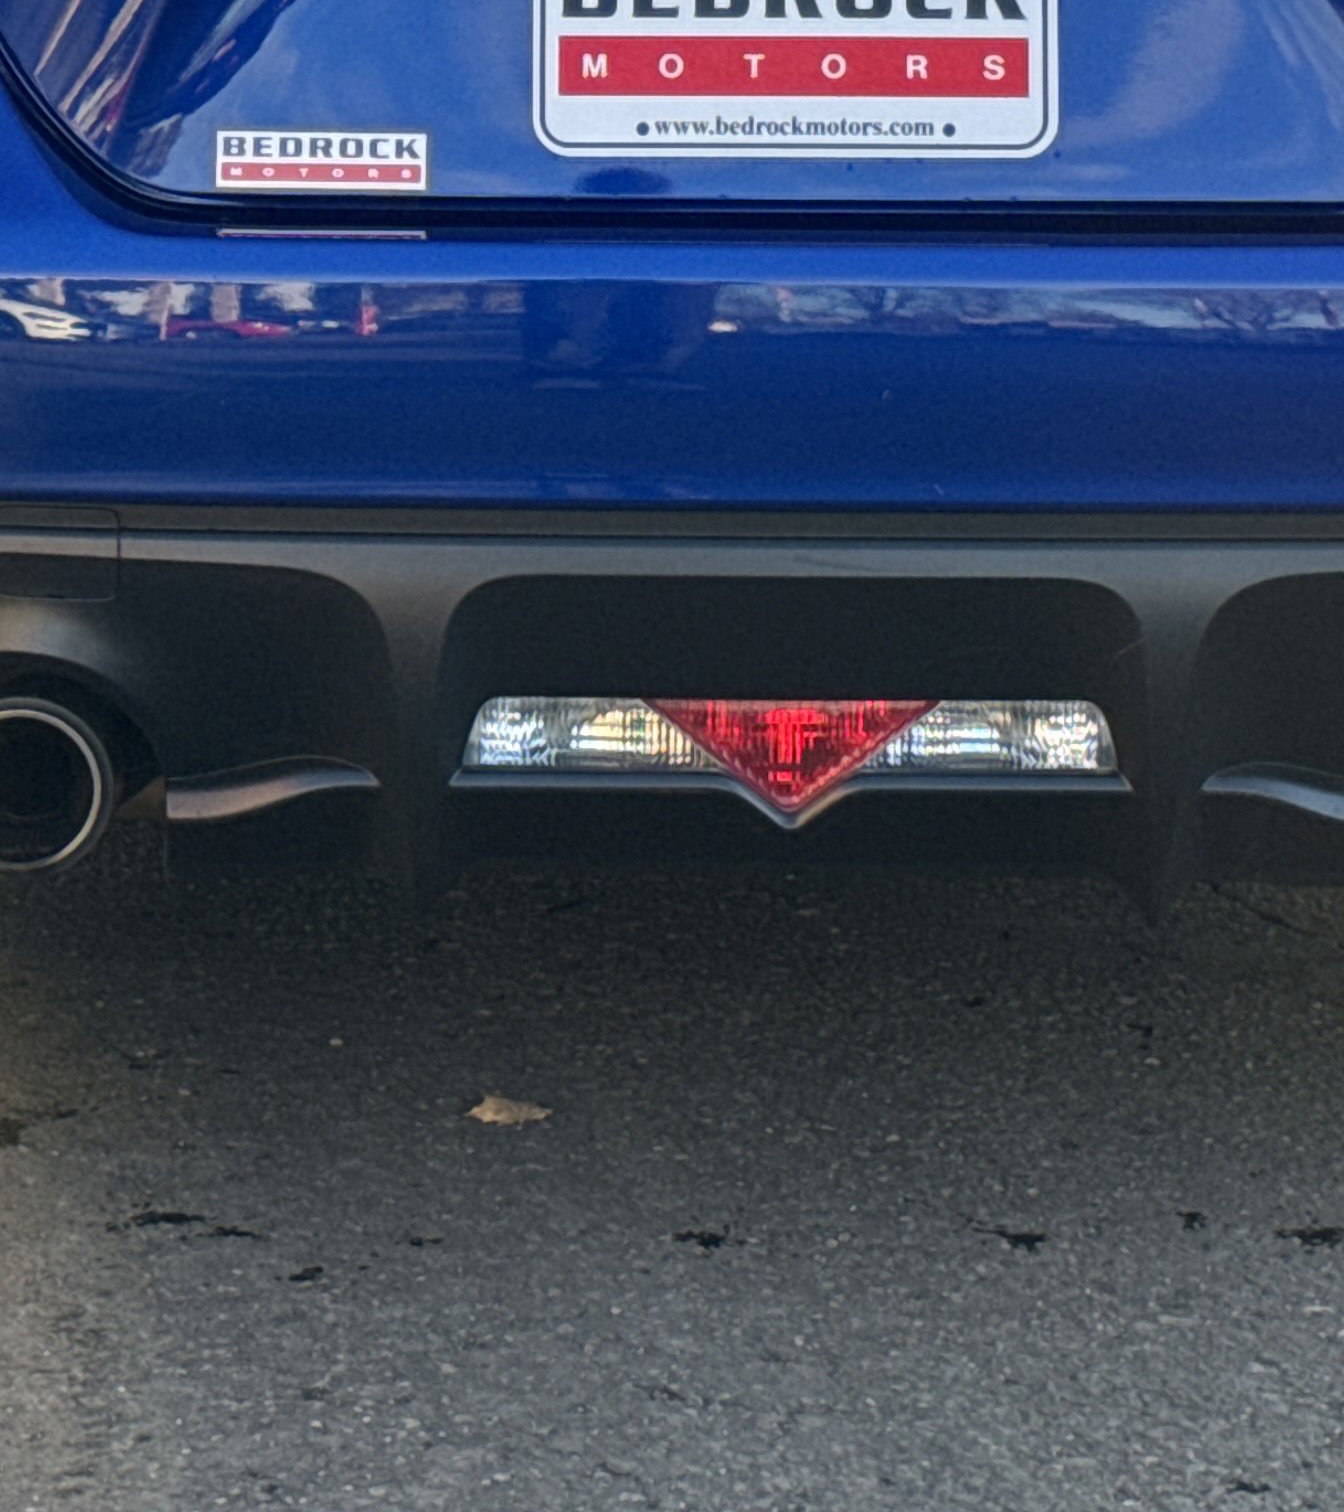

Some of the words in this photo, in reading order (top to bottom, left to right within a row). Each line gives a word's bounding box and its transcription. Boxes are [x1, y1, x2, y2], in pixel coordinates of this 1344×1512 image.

[582, 53, 1006, 81] MOTORS
[654, 116, 935, 138] www.bedrockmotors.com
[222, 136, 421, 160] BEDROCK
[230, 167, 412, 180] MOTORS
